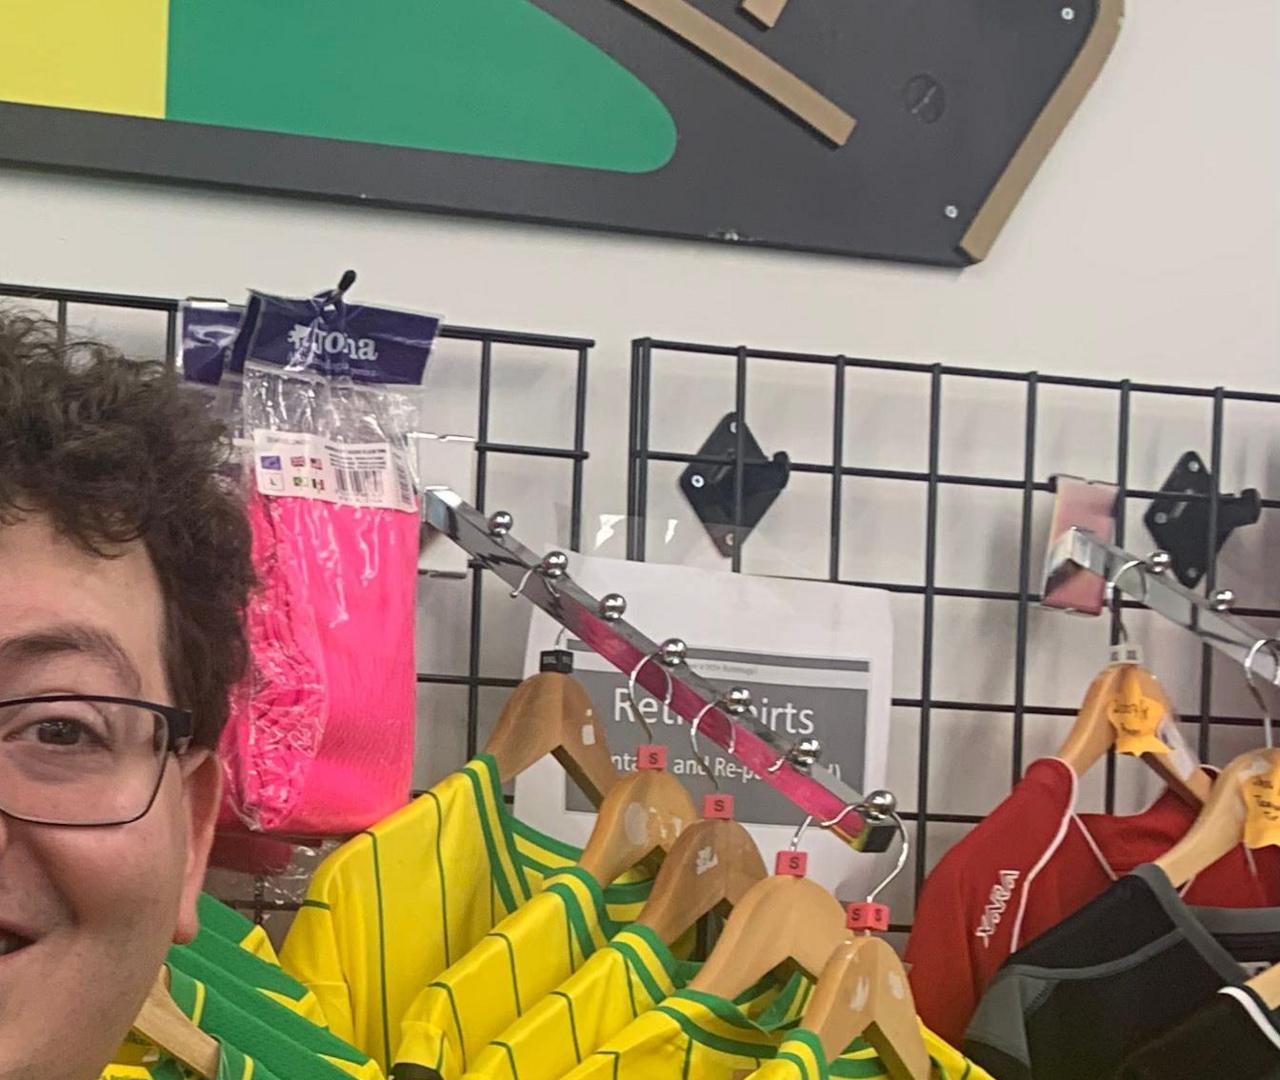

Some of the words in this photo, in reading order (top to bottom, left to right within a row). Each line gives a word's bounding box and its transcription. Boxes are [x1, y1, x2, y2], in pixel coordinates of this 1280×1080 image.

[613, 686, 684, 726] Ret
[749, 696, 816, 735] irts
[649, 752, 658, 765] S
[672, 754, 709, 776] and
[713, 799, 724, 812] S
[788, 856, 800, 870] S
[851, 907, 861, 921] S
